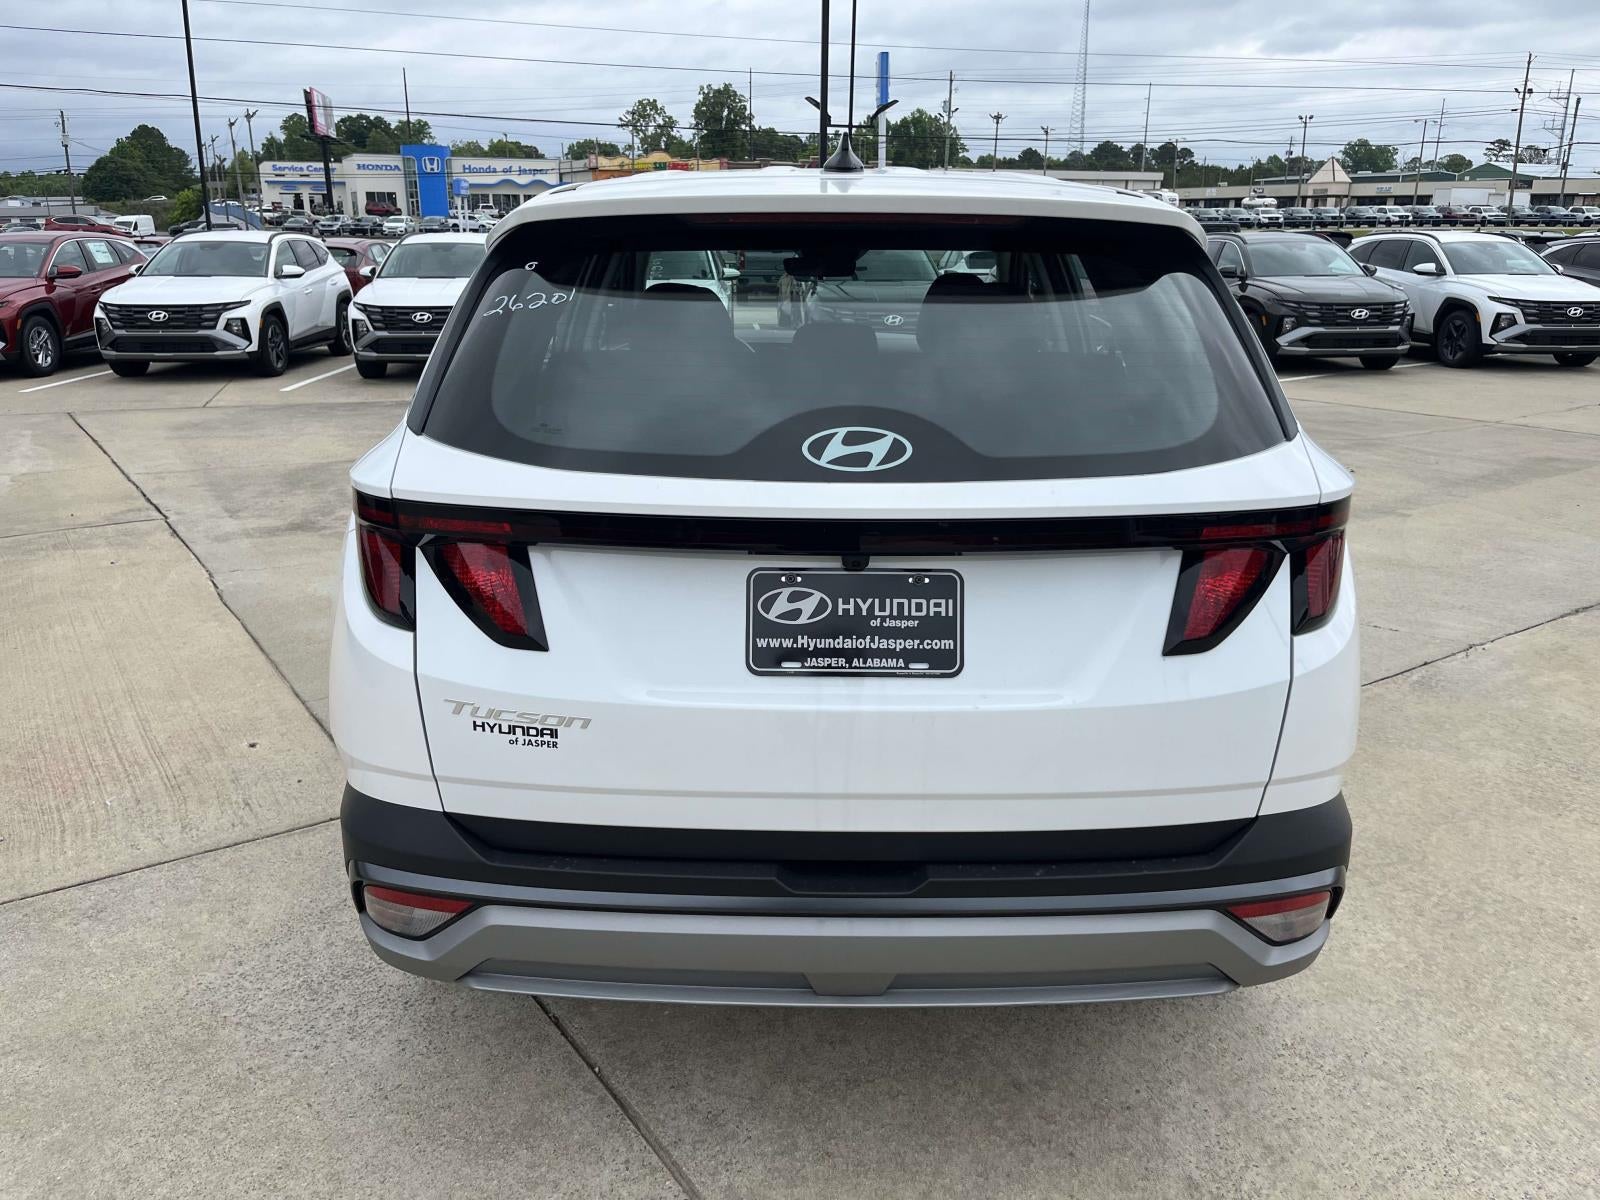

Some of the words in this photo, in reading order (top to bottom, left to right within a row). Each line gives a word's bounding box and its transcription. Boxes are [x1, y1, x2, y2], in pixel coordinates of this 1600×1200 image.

[272, 164, 305, 173] Service
[306, 165, 337, 173] Cenr
[356, 163, 402, 171] HONDA
[463, 164, 497, 174] Honda
[502, 165, 513, 174] of
[483, 288, 576, 317] 26201
[837, 598, 953, 617] HYUNDAI
[870, 617, 881, 627] of
[883, 618, 919, 629] Jasper
[756, 635, 954, 651] www.HyundaiofJasper.com
[804, 657, 849, 669] JASPER,
[851, 658, 905, 668] ALABAMA
[472, 720, 559, 740] HYUNDAI
[508, 737, 519, 746] of
[521, 738, 559, 749] JASPER
